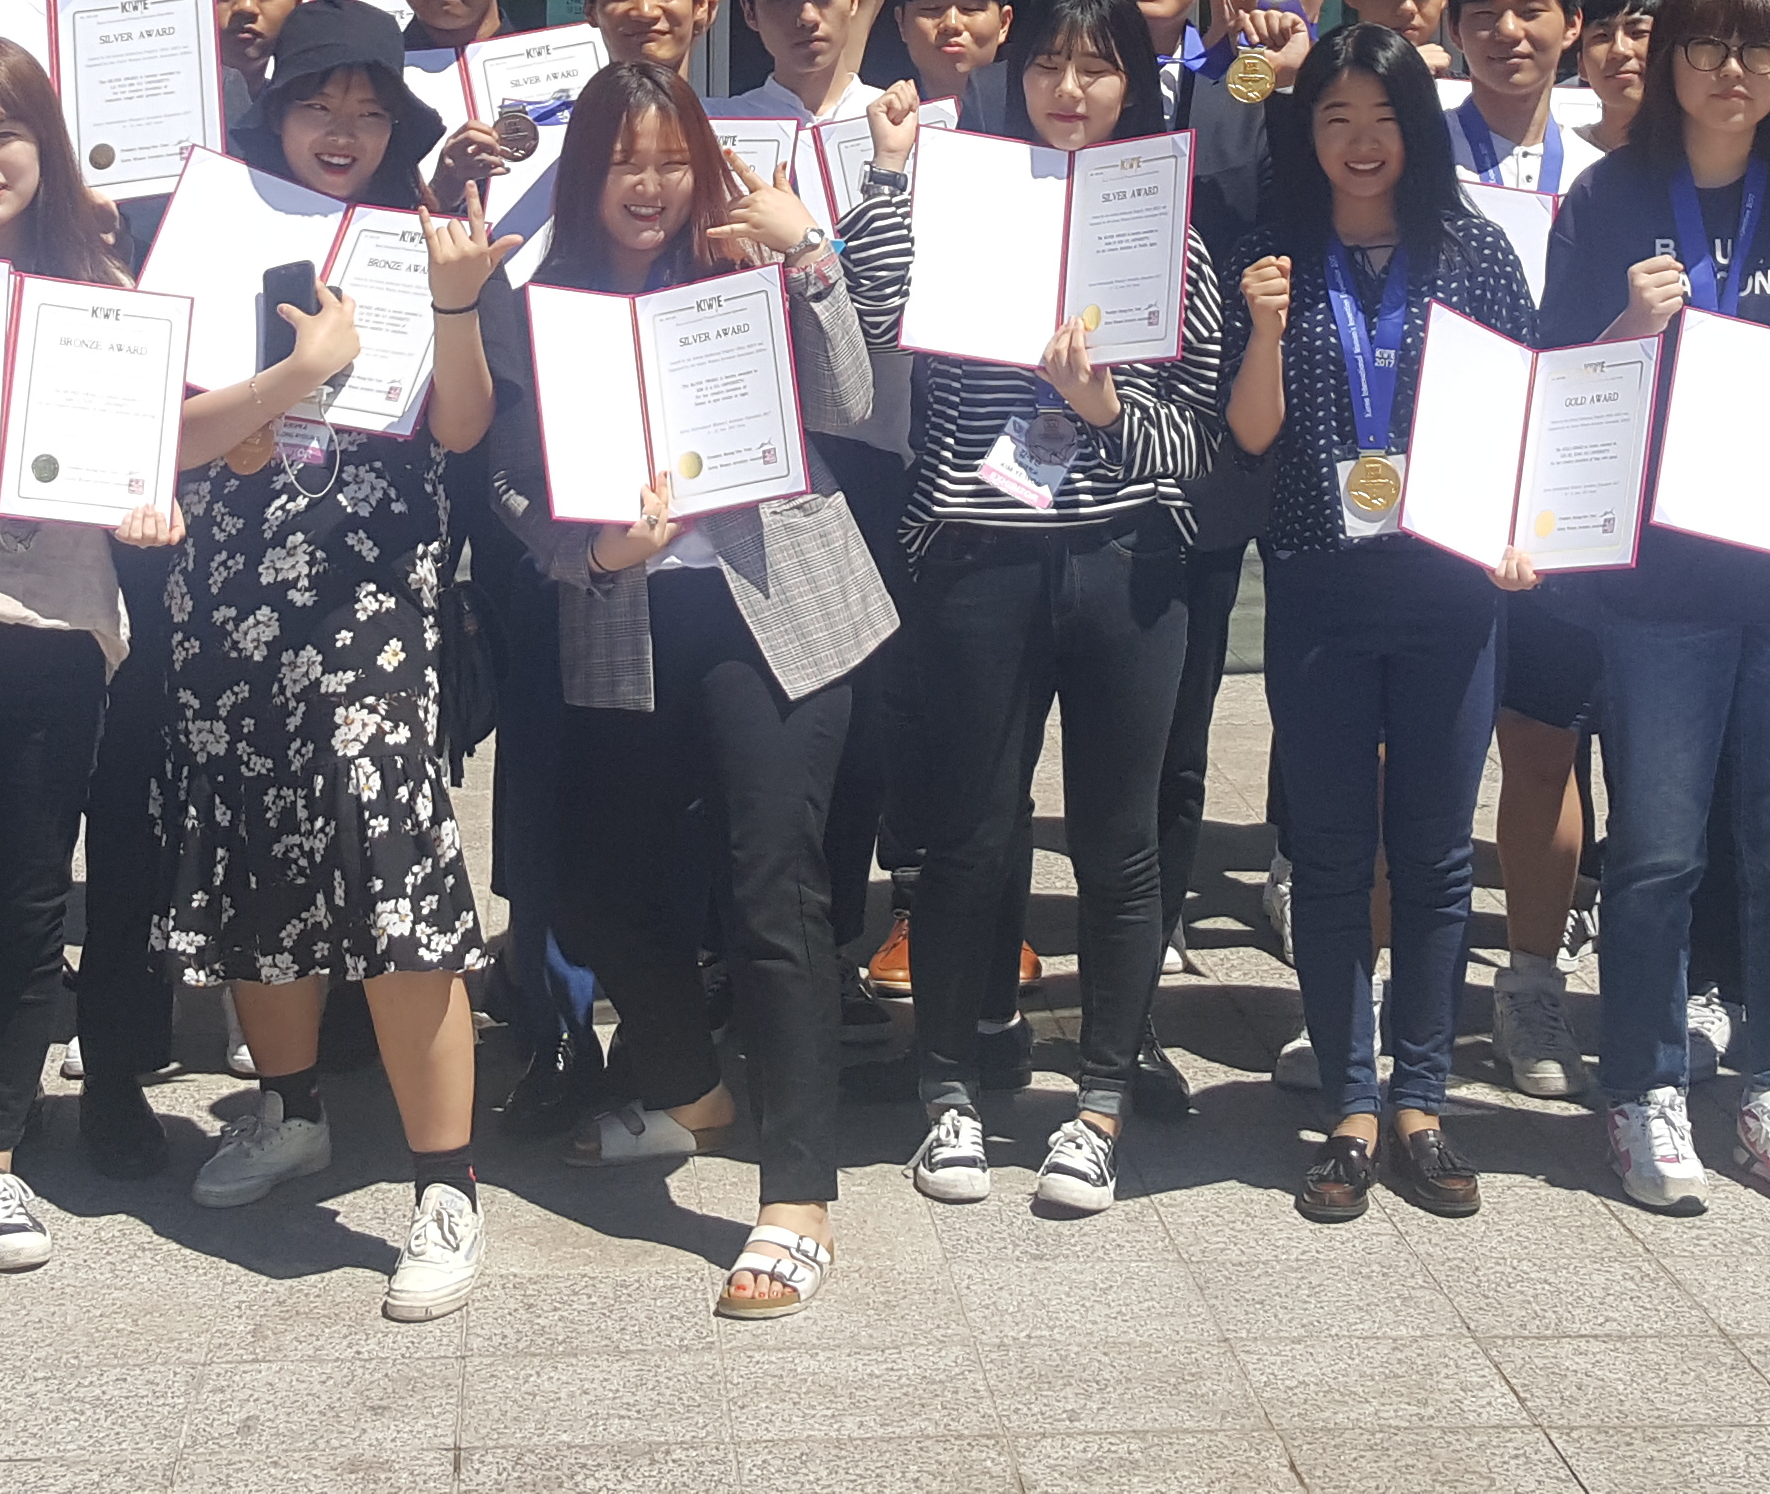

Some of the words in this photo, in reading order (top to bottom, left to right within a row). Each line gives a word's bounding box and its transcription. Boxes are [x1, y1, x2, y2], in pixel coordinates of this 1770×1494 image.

[99, 32, 133, 44] SILVER
[139, 26, 175, 39] AWARD
[510, 76, 541, 88] SILVER
[546, 69, 579, 82] AWARD
[1101, 189, 1128, 203] SILVER
[1130, 186, 1159, 199] AWARD
[367, 258, 403, 271] BRONZE
[679, 332, 711, 347] SILVER
[715, 323, 750, 340] AWARD
[59, 336, 103, 351] BRONZE
[108, 342, 148, 356] AWARD
[1374, 358, 1395, 367] 2017
[1589, 392, 1619, 405] AWARD
